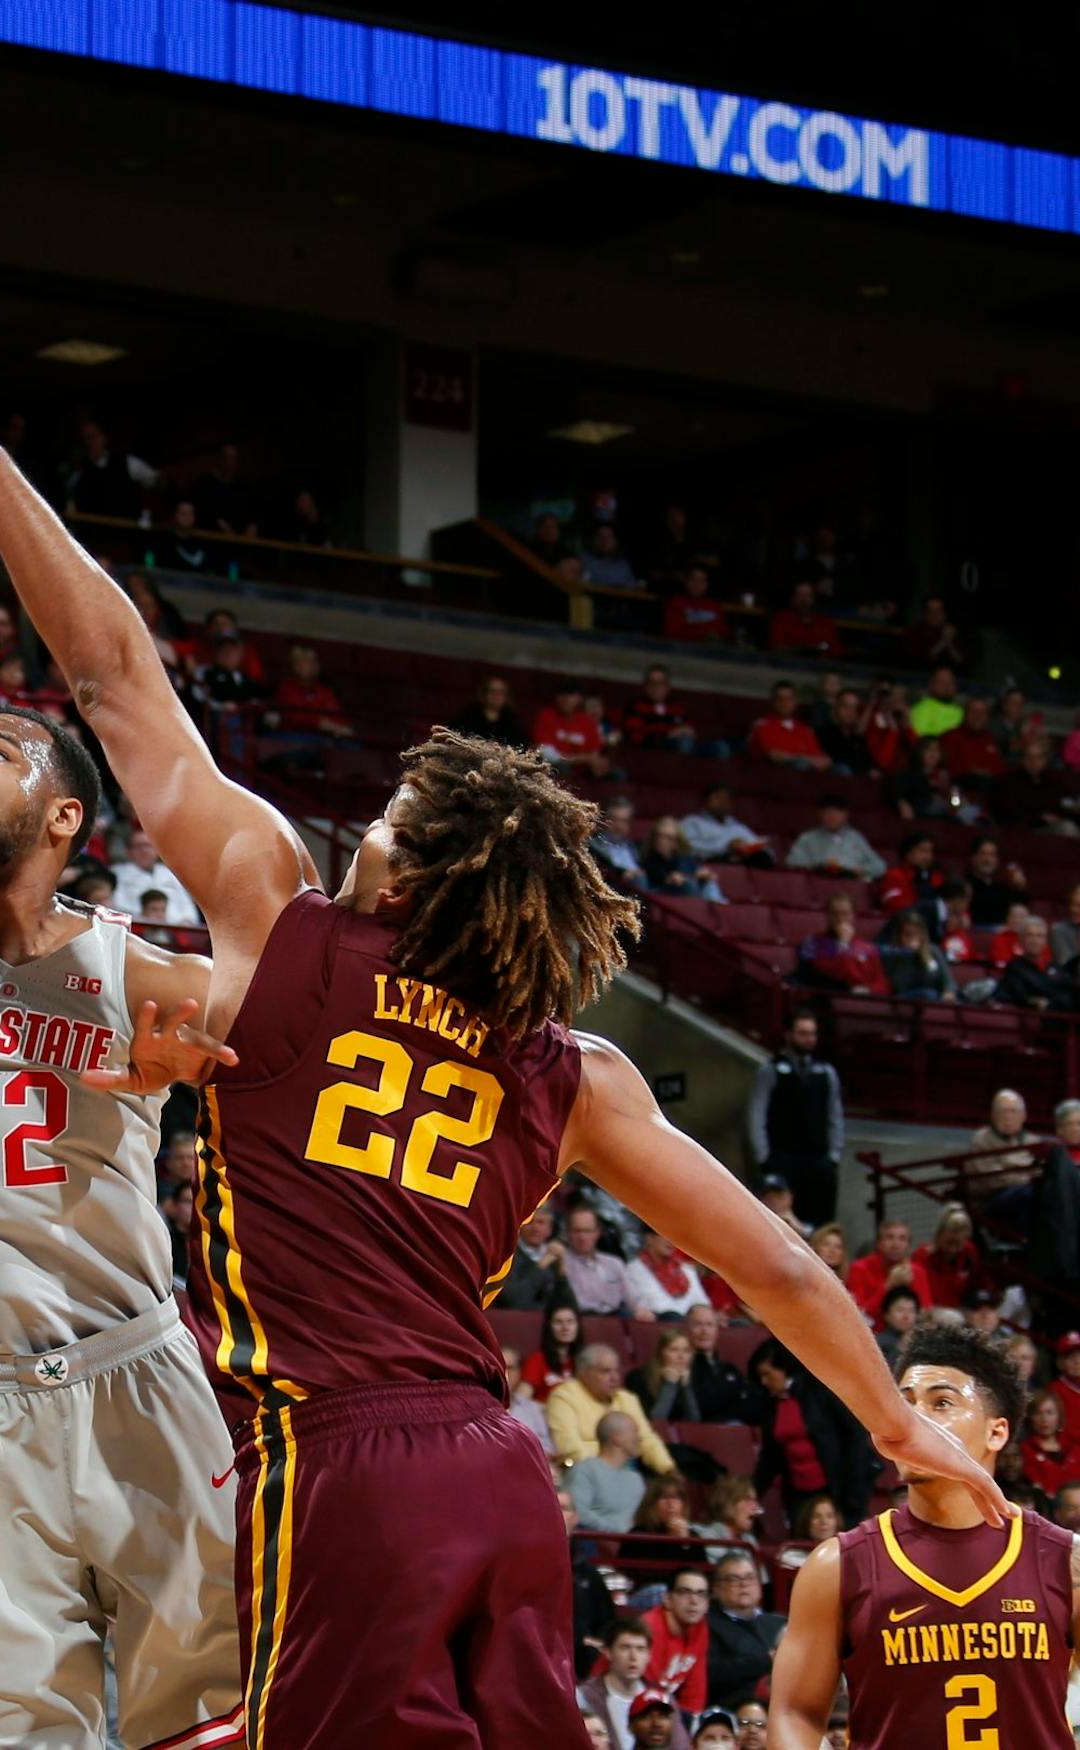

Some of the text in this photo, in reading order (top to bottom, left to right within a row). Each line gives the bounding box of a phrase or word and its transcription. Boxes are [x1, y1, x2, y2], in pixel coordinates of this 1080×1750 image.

[536, 63, 930, 208] 10TV.COM
[374, 973, 491, 1059] LYNCH
[304, 1029, 506, 1209] 22
[881, 1621, 1051, 1666] MINNESOTA
[944, 1673, 1000, 1750] 2
